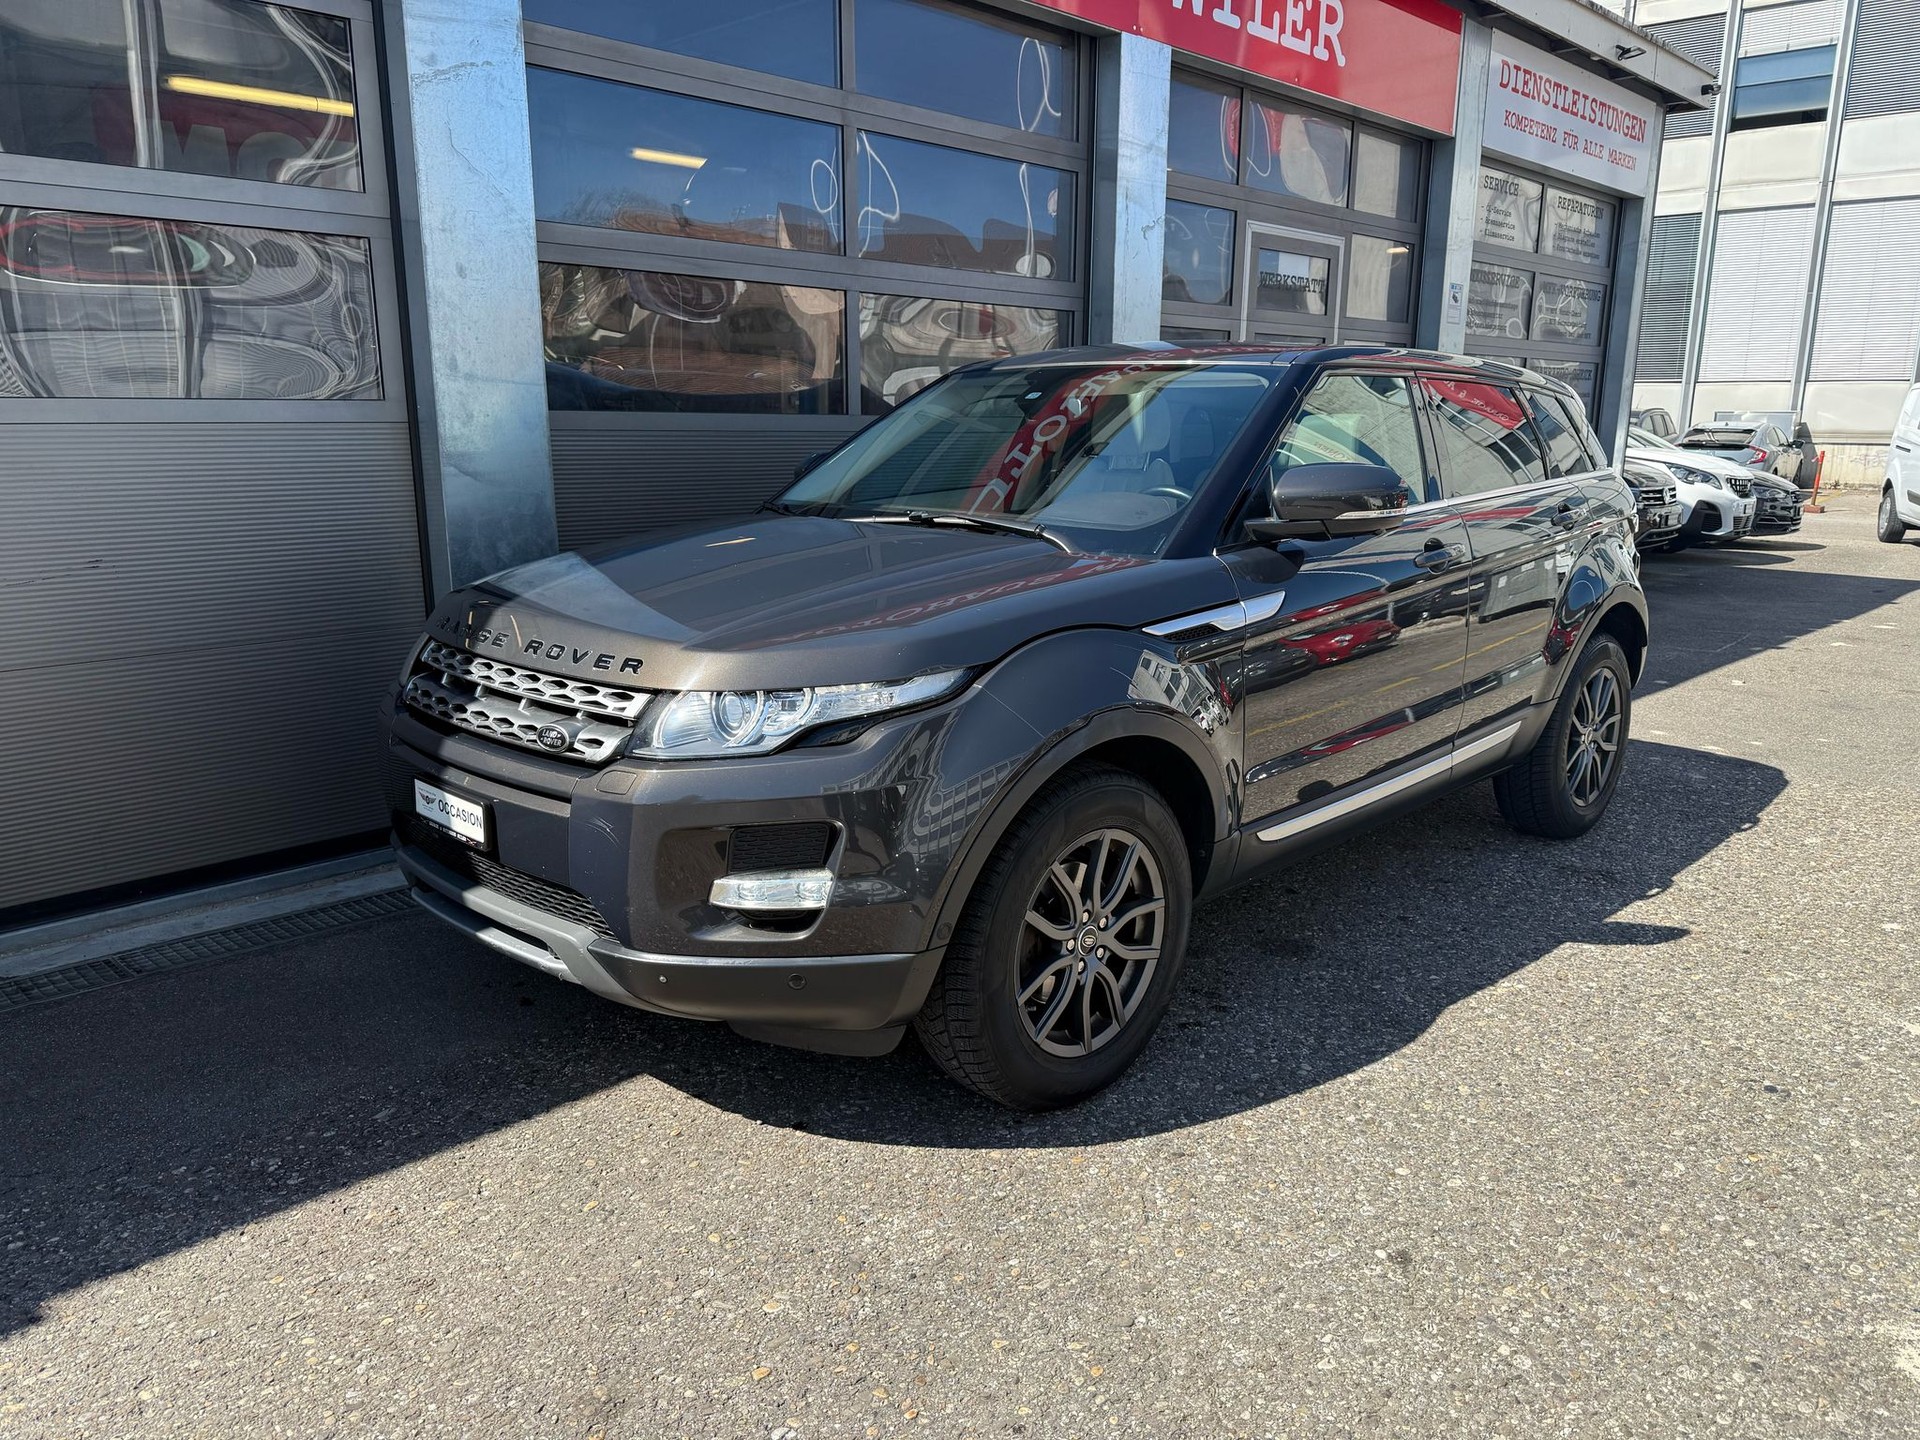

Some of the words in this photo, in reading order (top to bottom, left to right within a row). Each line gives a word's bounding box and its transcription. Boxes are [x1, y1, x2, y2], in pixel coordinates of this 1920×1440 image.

[1499, 59, 1647, 143] DIENSTLEISTUNGEN
[1503, 109, 1557, 142] KOMPETENZ
[1562, 127, 1579, 152] FÜR
[1583, 139, 1604, 160] ALLE
[1608, 147, 1637, 171] MARKEN
[1483, 174, 1520, 197] SERVICE
[1557, 195, 1604, 220] REPARATUREN
[1259, 271, 1326, 294] WERKSTATT
[523, 638, 645, 675] ROVER
[541, 728, 559, 739] LAND
[542, 736, 562, 747] ROVER
[437, 799, 483, 830] OCCASION
